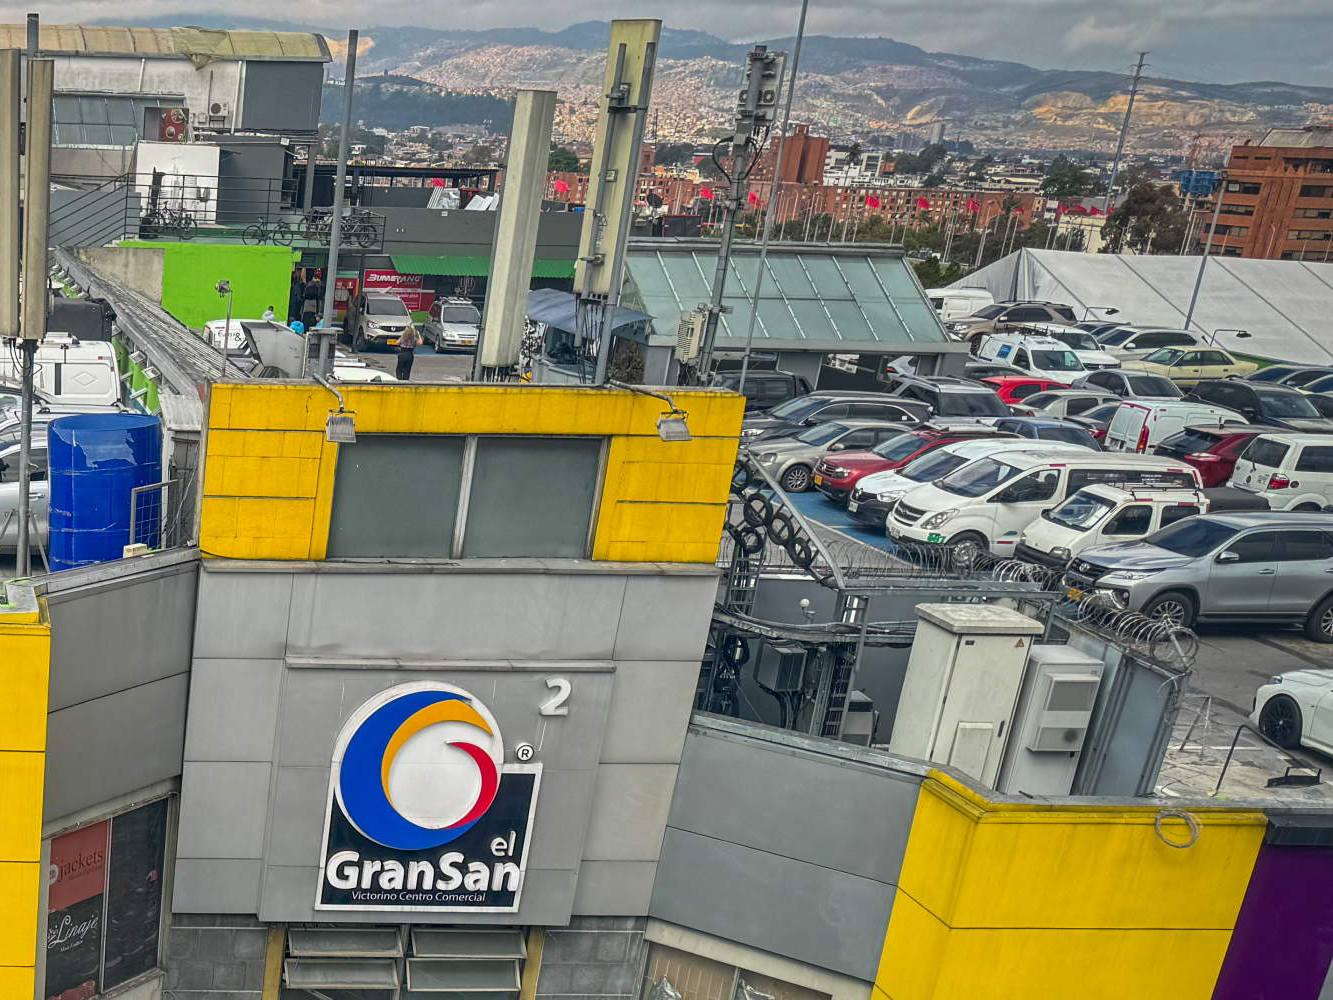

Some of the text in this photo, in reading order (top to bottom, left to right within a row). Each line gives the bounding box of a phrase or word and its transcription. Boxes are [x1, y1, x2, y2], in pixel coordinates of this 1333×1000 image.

[539, 676, 572, 716] 2
[490, 830, 517, 857] el
[58, 850, 104, 882] jackets
[326, 850, 520, 892] GranSan
[351, 890, 486, 902] Victorino Centro Comercial
[48, 914, 99, 949] Linaje
